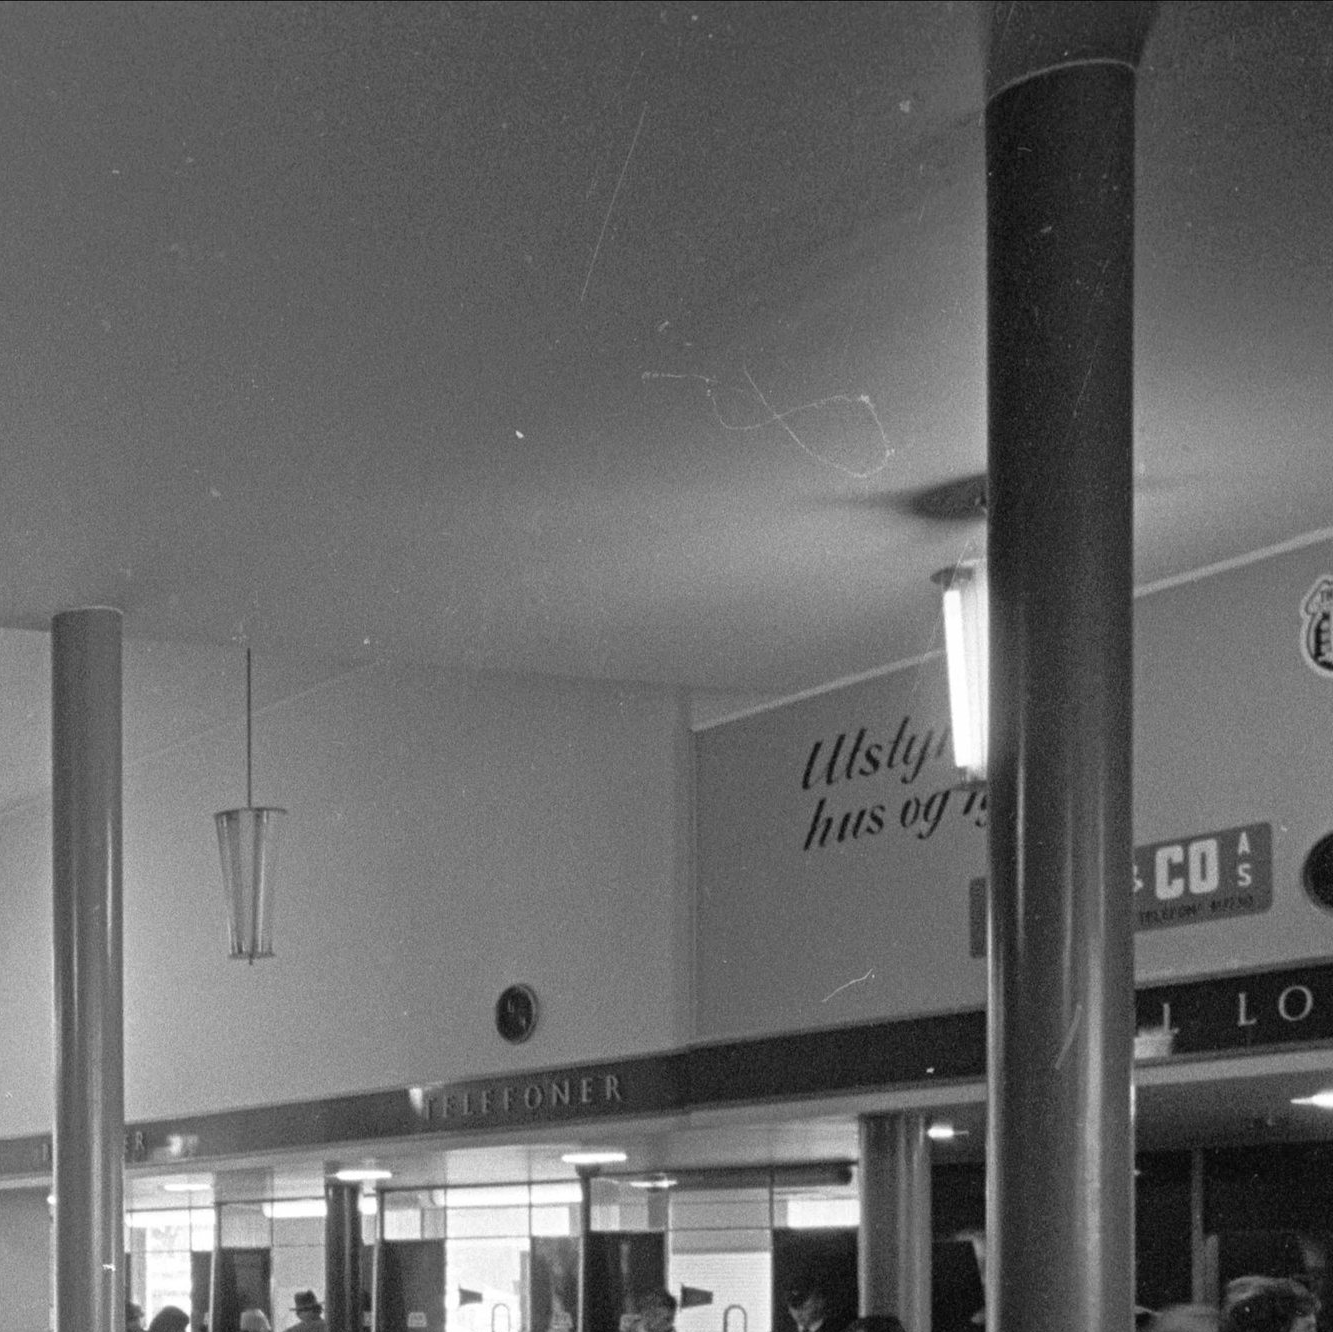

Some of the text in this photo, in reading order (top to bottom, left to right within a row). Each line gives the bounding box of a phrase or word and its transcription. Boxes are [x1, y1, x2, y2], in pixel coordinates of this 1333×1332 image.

[803, 797, 886, 851] hus
[900, 789, 951, 840] og
[1155, 838, 1219, 900] CO
[421, 1073, 622, 1120] TELEFONER
